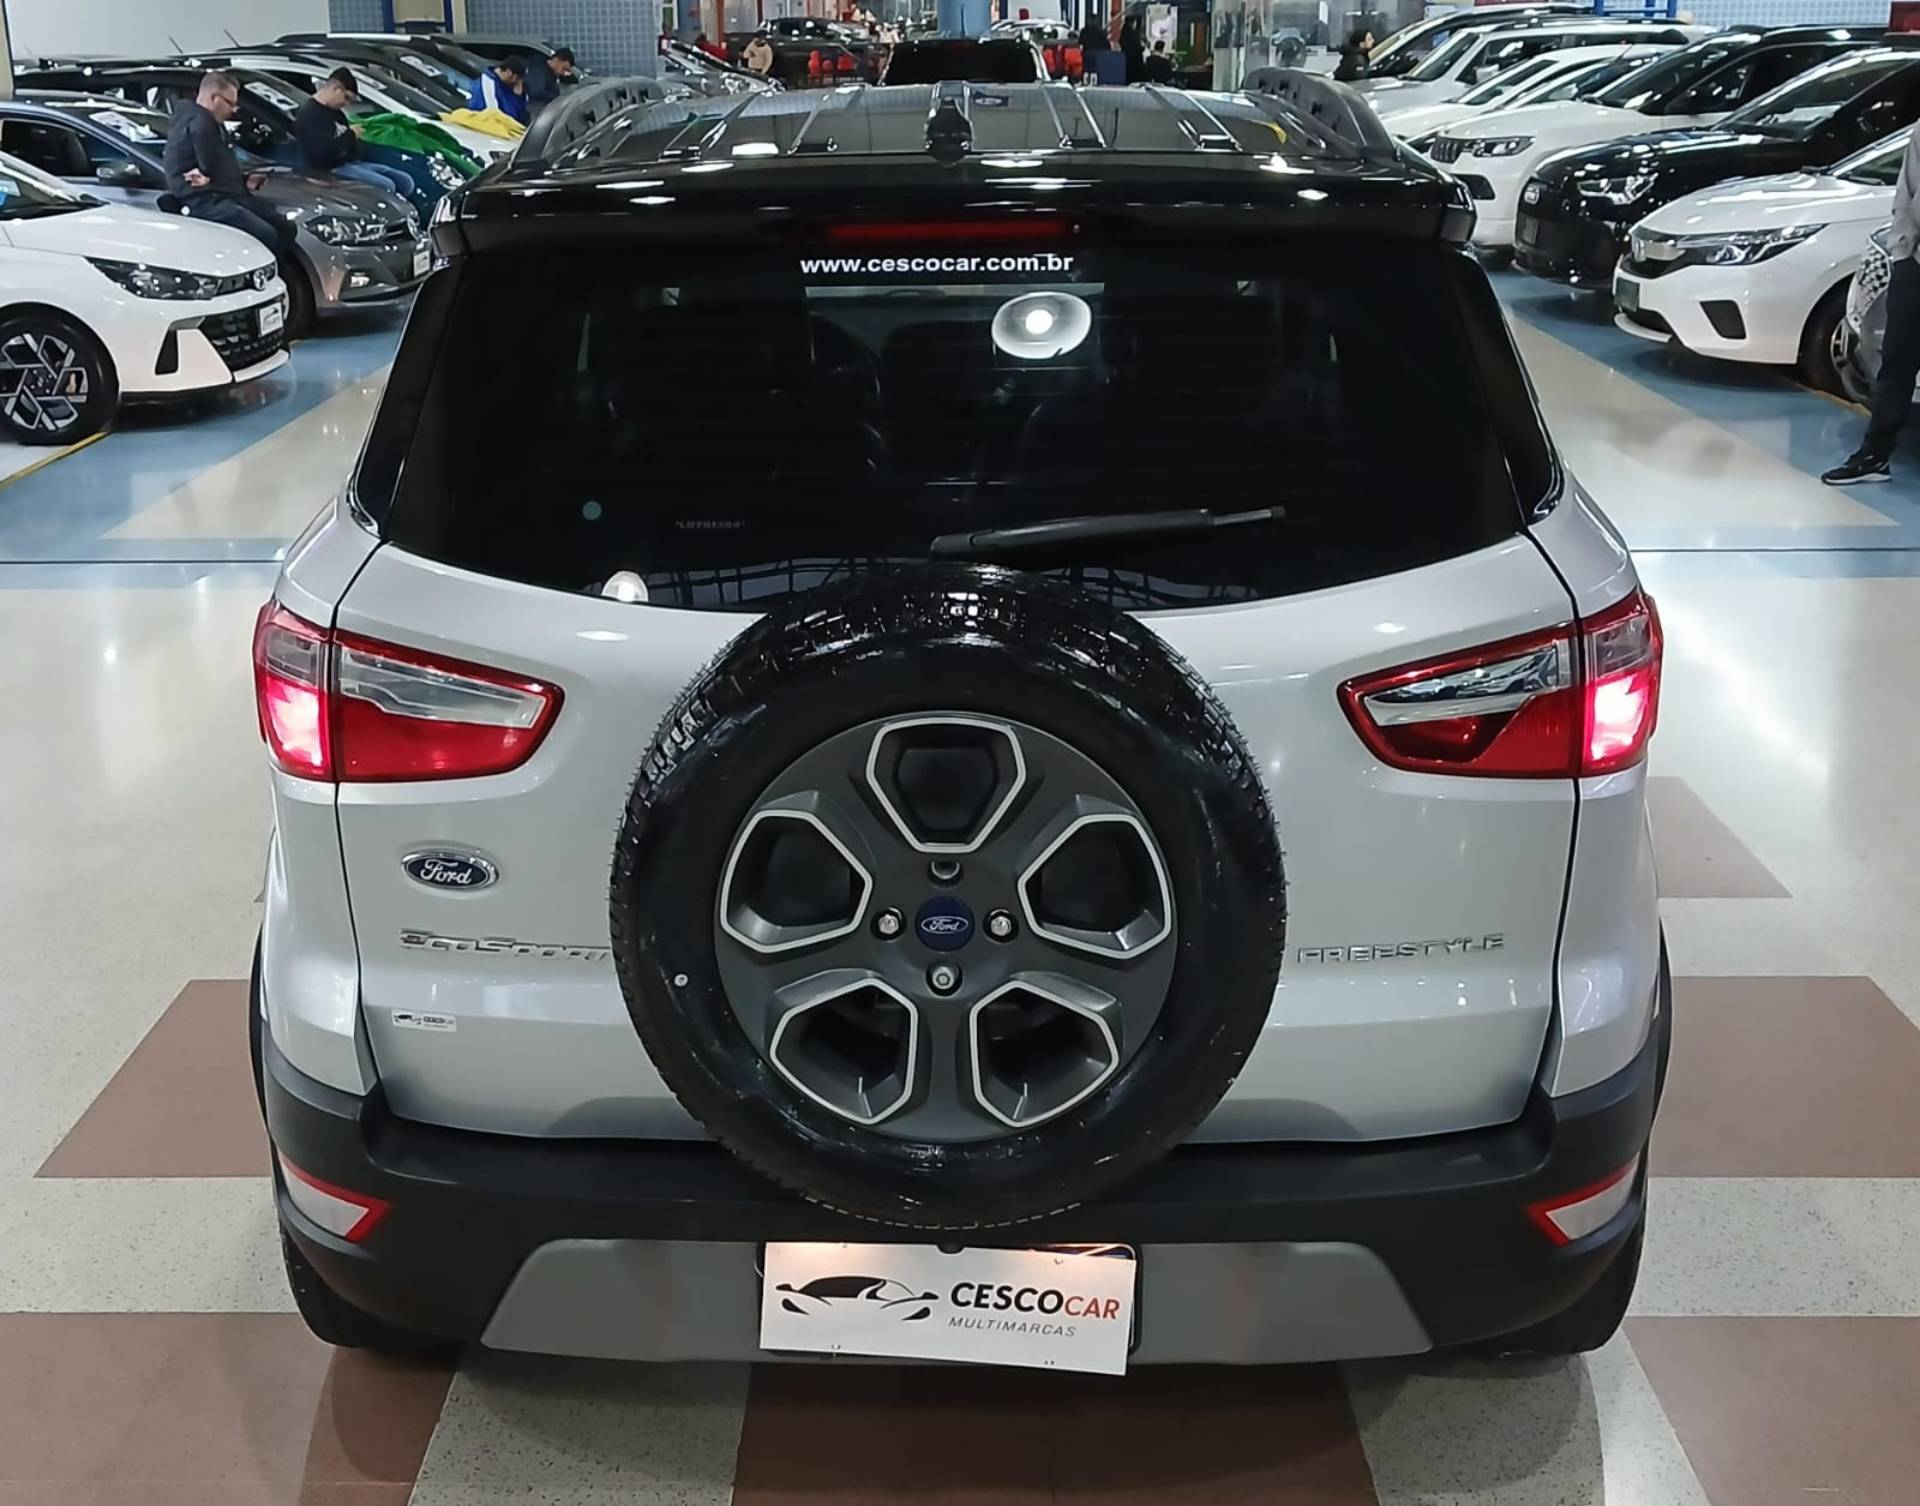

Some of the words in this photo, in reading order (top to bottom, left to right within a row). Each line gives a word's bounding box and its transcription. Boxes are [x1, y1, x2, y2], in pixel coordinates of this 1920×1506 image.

[800, 255, 1074, 273] www.cescocar.com.br
[420, 858, 472, 885] Ford
[929, 918, 960, 931] Ford
[1297, 932, 1505, 963] FREESTYLE
[950, 1282, 1121, 1320] CESCOCAR
[948, 1317, 1077, 1338] MULTIMARCAS
